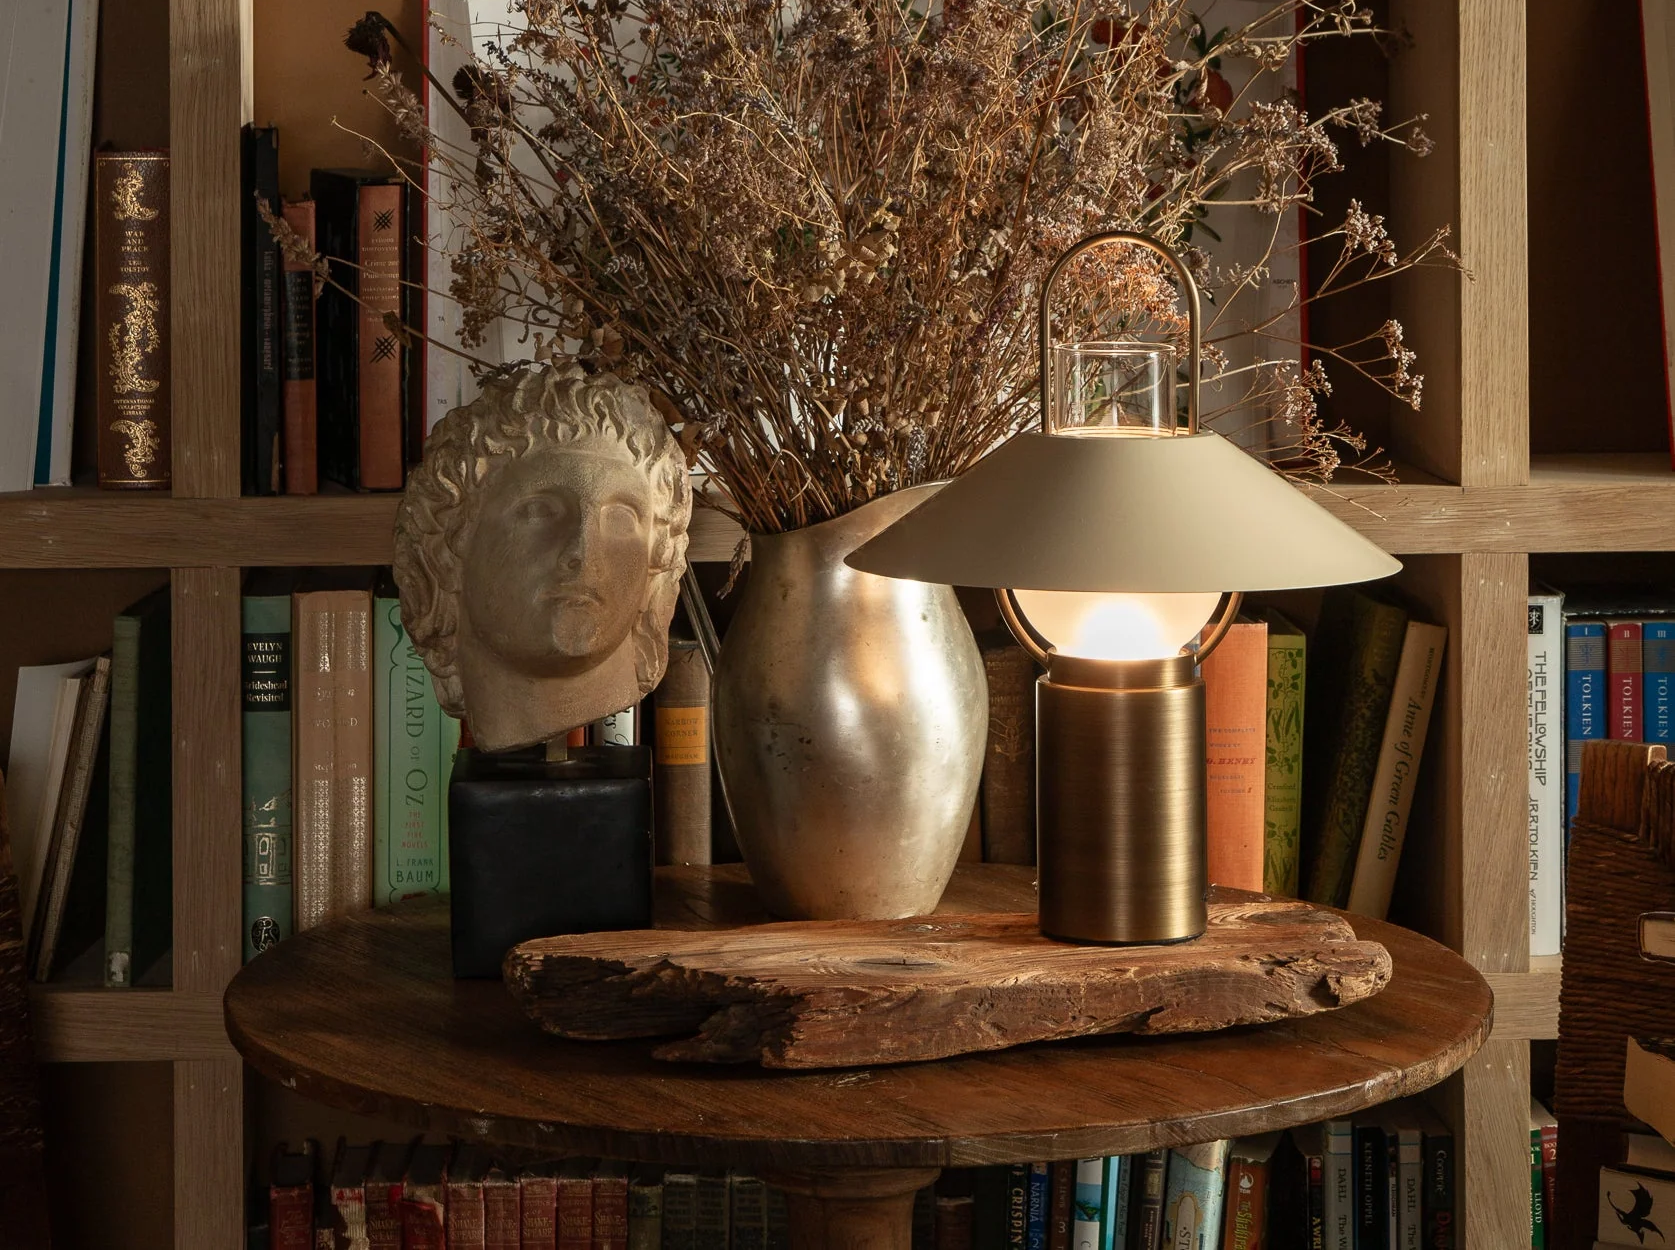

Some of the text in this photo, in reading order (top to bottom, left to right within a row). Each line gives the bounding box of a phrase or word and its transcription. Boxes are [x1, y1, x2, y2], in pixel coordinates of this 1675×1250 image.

[125, 230, 145, 238] WAR
[247, 642, 283, 652] EVELYN
[247, 654, 283, 664] WAUGH
[247, 693, 284, 703] Revisited
[1534, 651, 1547, 787] THE FELLOWSHIP
[1581, 673, 1593, 735] TOLKIEN
[1621, 676, 1633, 737] TOLKIEN
[1657, 677, 1669, 738] TOLKIEN
[410, 746, 420, 760] OF
[405, 769, 428, 806] OZ
[1377, 696, 1423, 861] Anne of Green Gables
[396, 871, 433, 883] BAUM
[1364, 1141, 1373, 1191] KENNETH
[1010, 1187, 1024, 1244] CRISPIN
[1030, 1182, 1040, 1223] NARNIA
[1338, 1168, 1347, 1235] DAHL The
[1407, 1178, 1416, 1245] DAHL The
[1534, 1192, 1542, 1223] LLOYD
